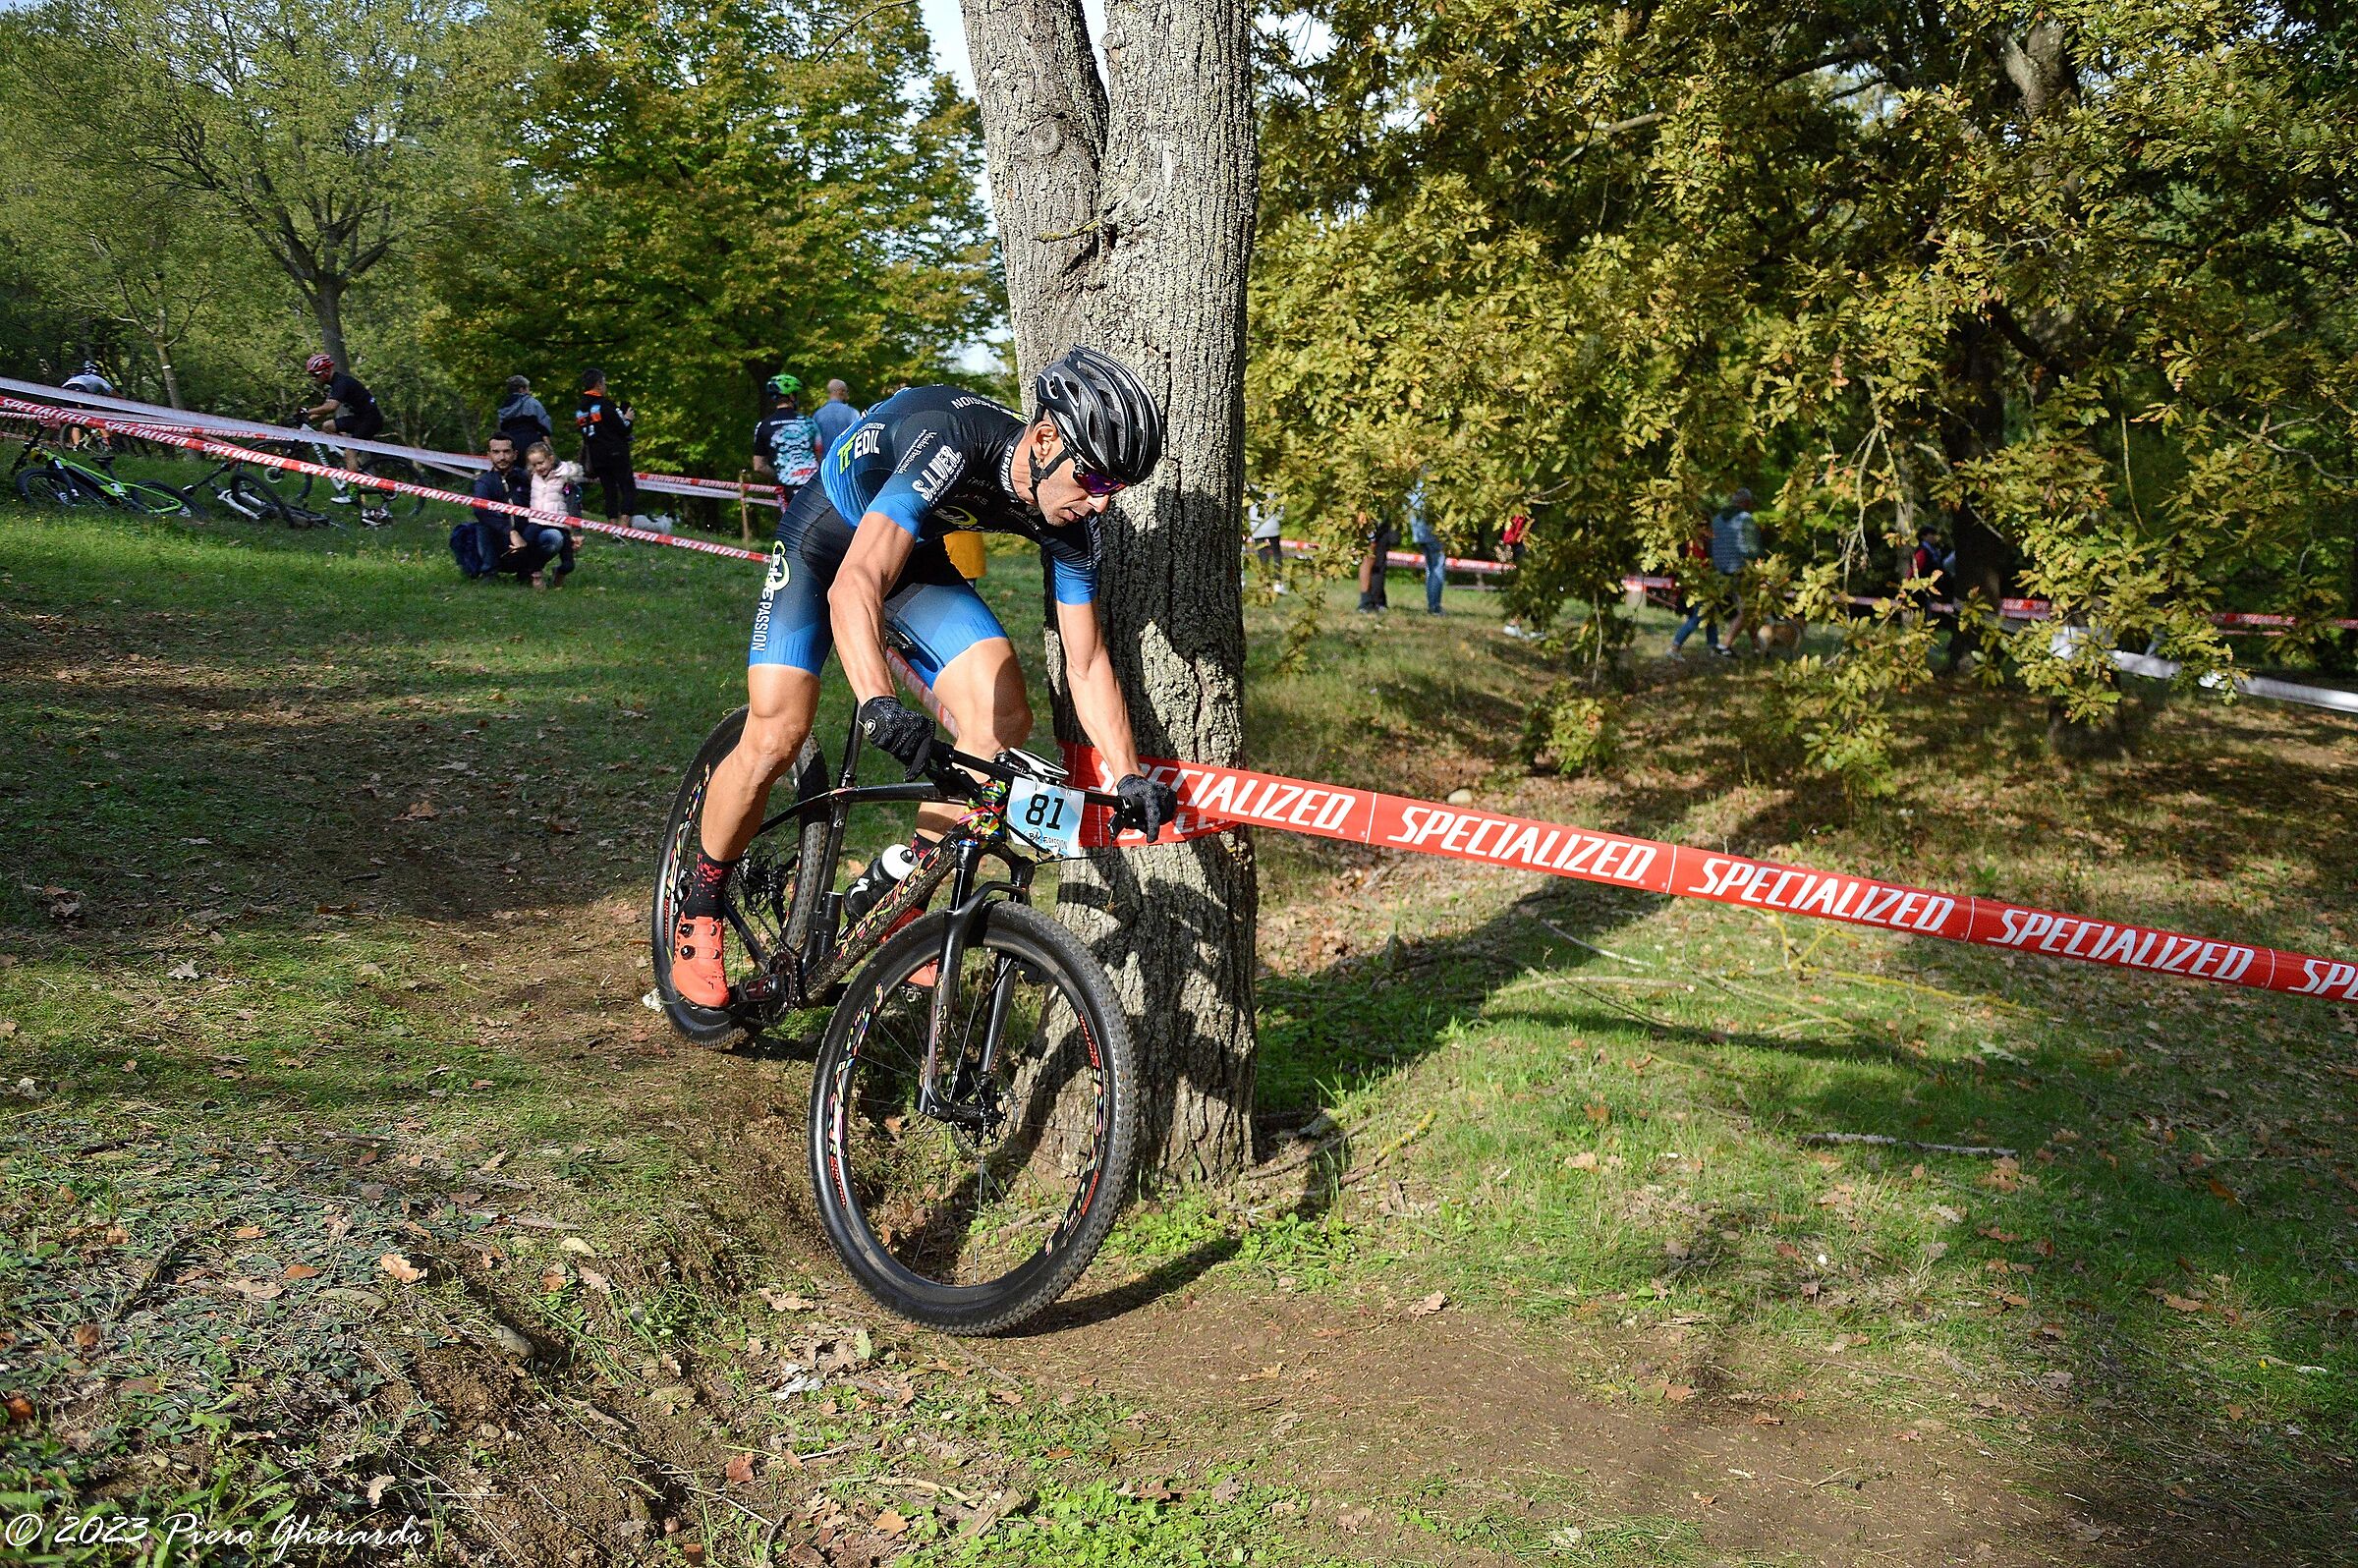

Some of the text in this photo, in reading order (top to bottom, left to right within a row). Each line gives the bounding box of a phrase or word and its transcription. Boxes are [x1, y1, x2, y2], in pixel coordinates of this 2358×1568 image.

[3, 397, 90, 425] SPECIALIZED
[104, 420, 190, 447] SPECIALIZED
[855, 429, 880, 460] EDIL
[202, 442, 286, 468] SPECIALIZED
[299, 463, 380, 486] SPECIALIZED
[752, 601, 774, 652] PASSION
[1025, 793, 1065, 831] 81
[1386, 806, 1658, 882] SPECIALIZED
[1688, 857, 1956, 932] SPECIALIZED
[1987, 909, 2256, 981] SPECIALIZED
